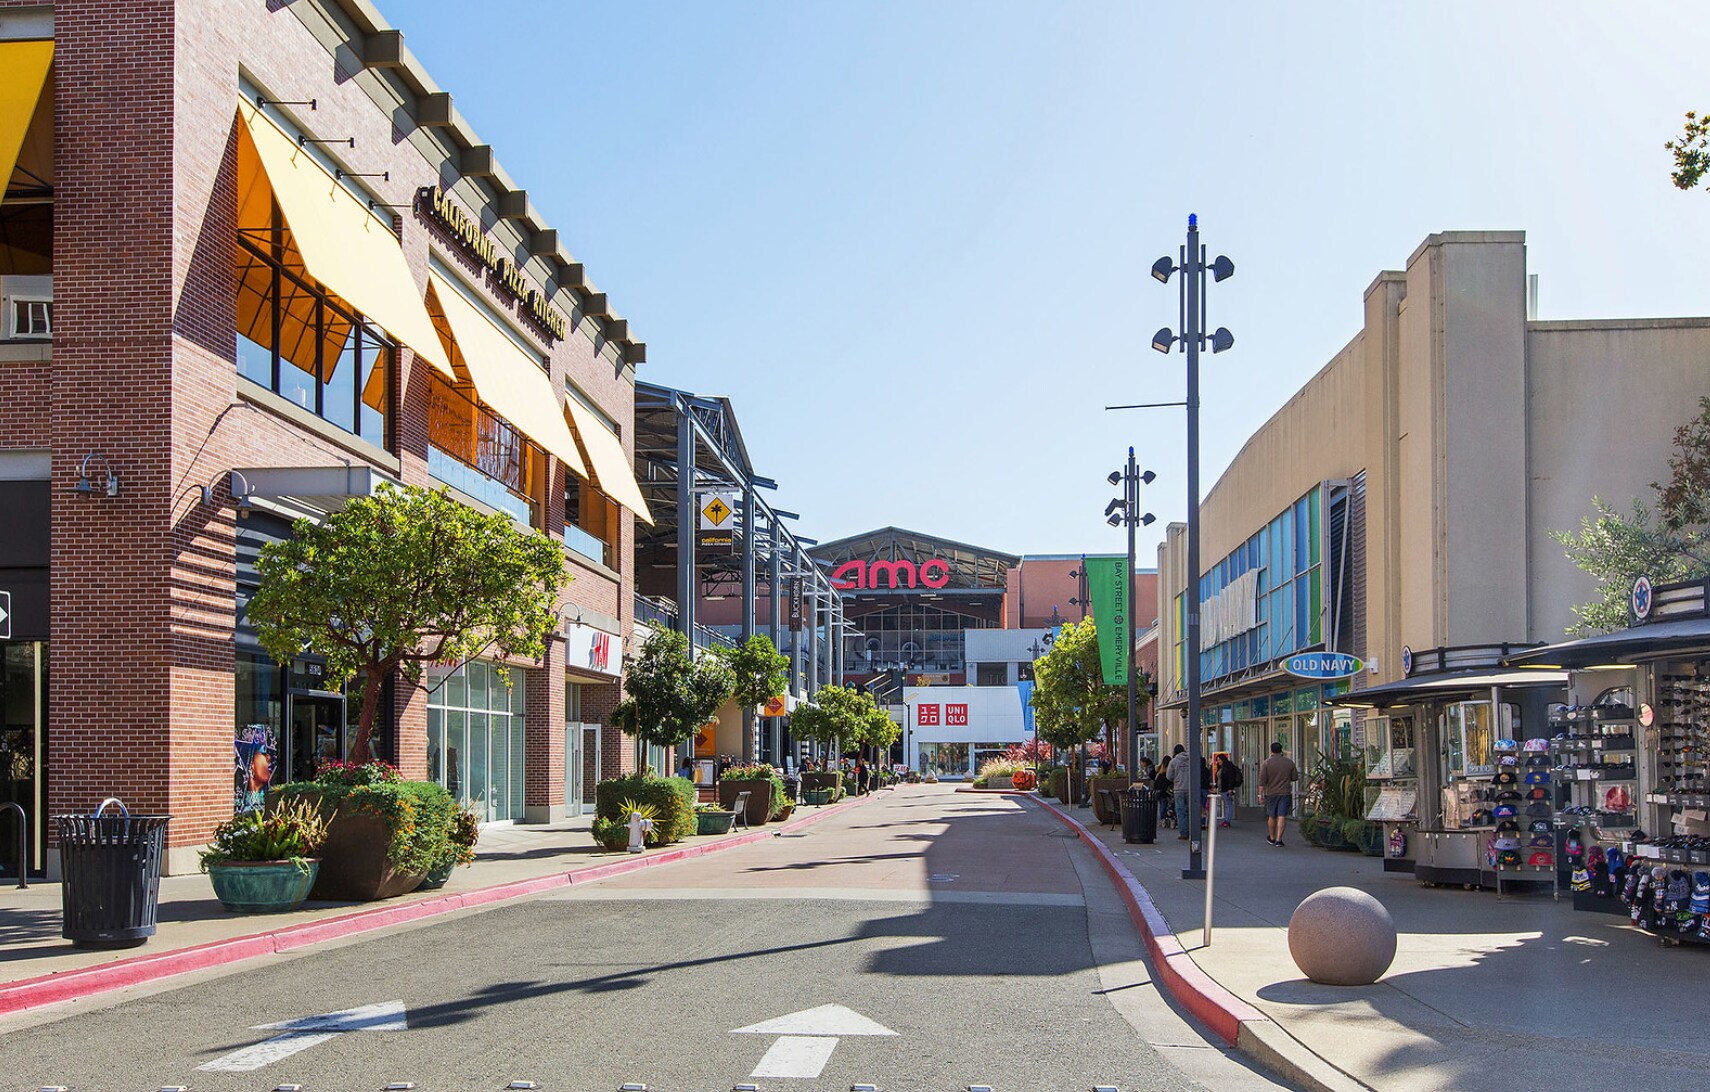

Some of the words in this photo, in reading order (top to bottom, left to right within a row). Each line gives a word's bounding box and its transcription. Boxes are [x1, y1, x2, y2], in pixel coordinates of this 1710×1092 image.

[433, 186, 498, 271] CALIFORNIA
[503, 260, 530, 302] PIZZA
[533, 292, 566, 340] KITCHEN
[1114, 562, 1123, 578] BAY
[1114, 581, 1123, 613] STREET
[1114, 626, 1123, 681] EMERYVILLE
[1292, 659, 1318, 671] OLD
[1321, 659, 1356, 671] NAVY
